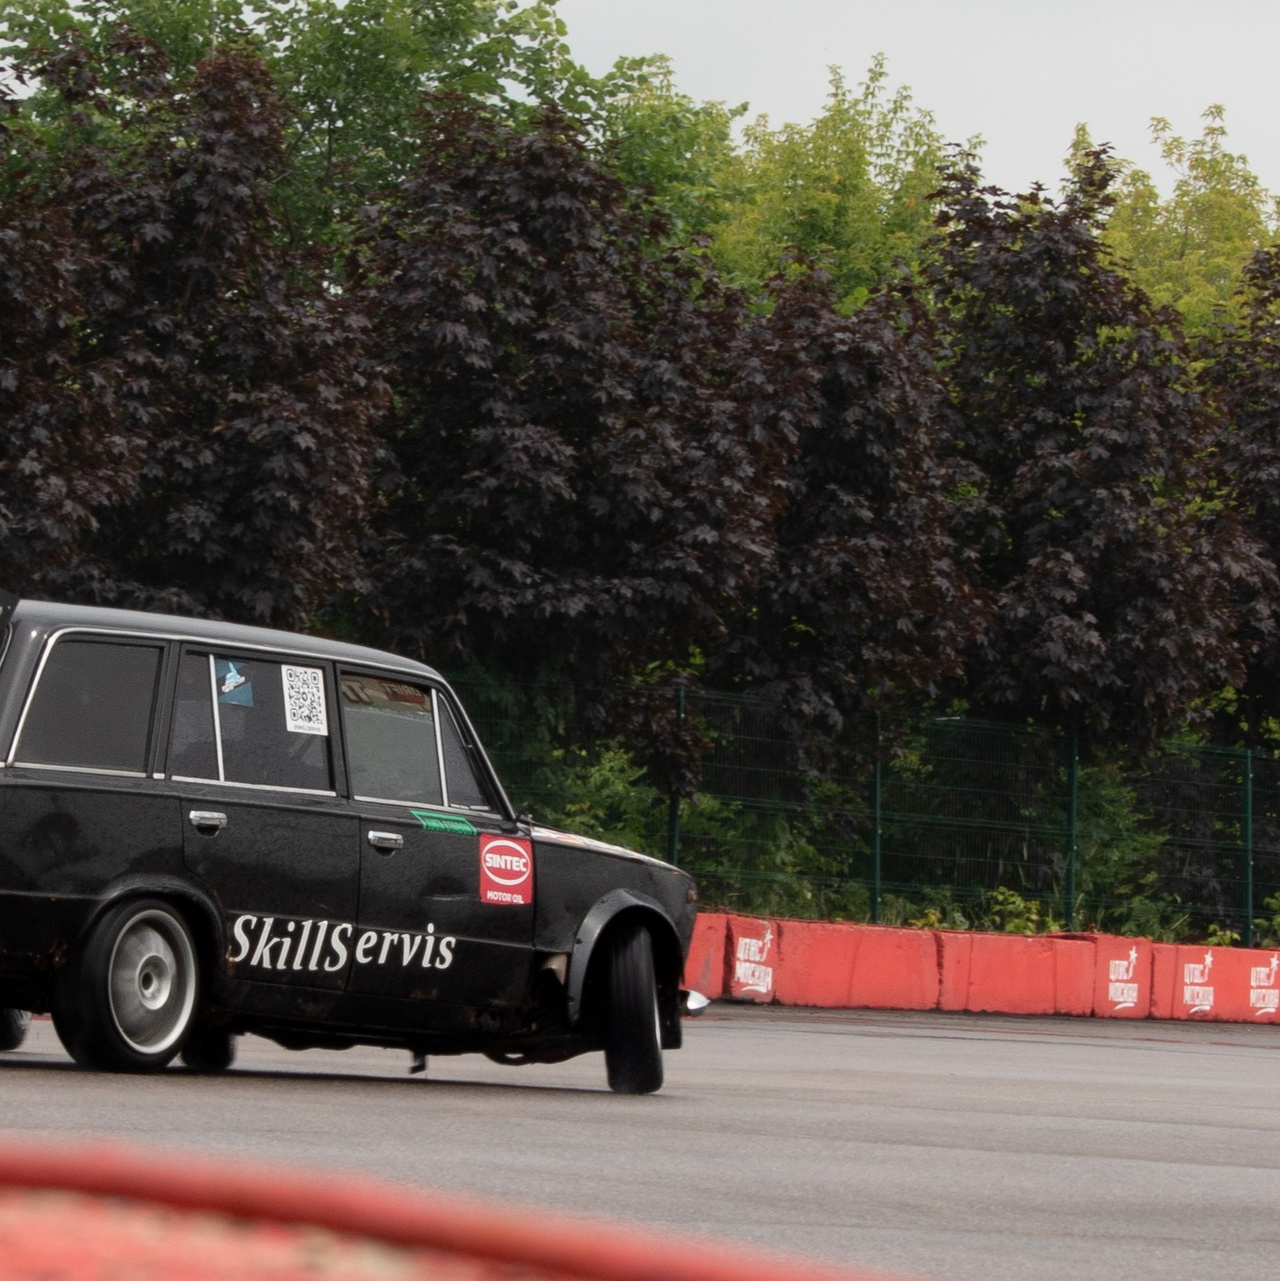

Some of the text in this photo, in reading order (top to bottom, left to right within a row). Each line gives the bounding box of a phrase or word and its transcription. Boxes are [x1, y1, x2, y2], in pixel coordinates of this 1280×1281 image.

[485, 853, 527, 872] SINTEC
[487, 890, 524, 904] MOTOR OIL
[227, 914, 457, 971] SkillServis
